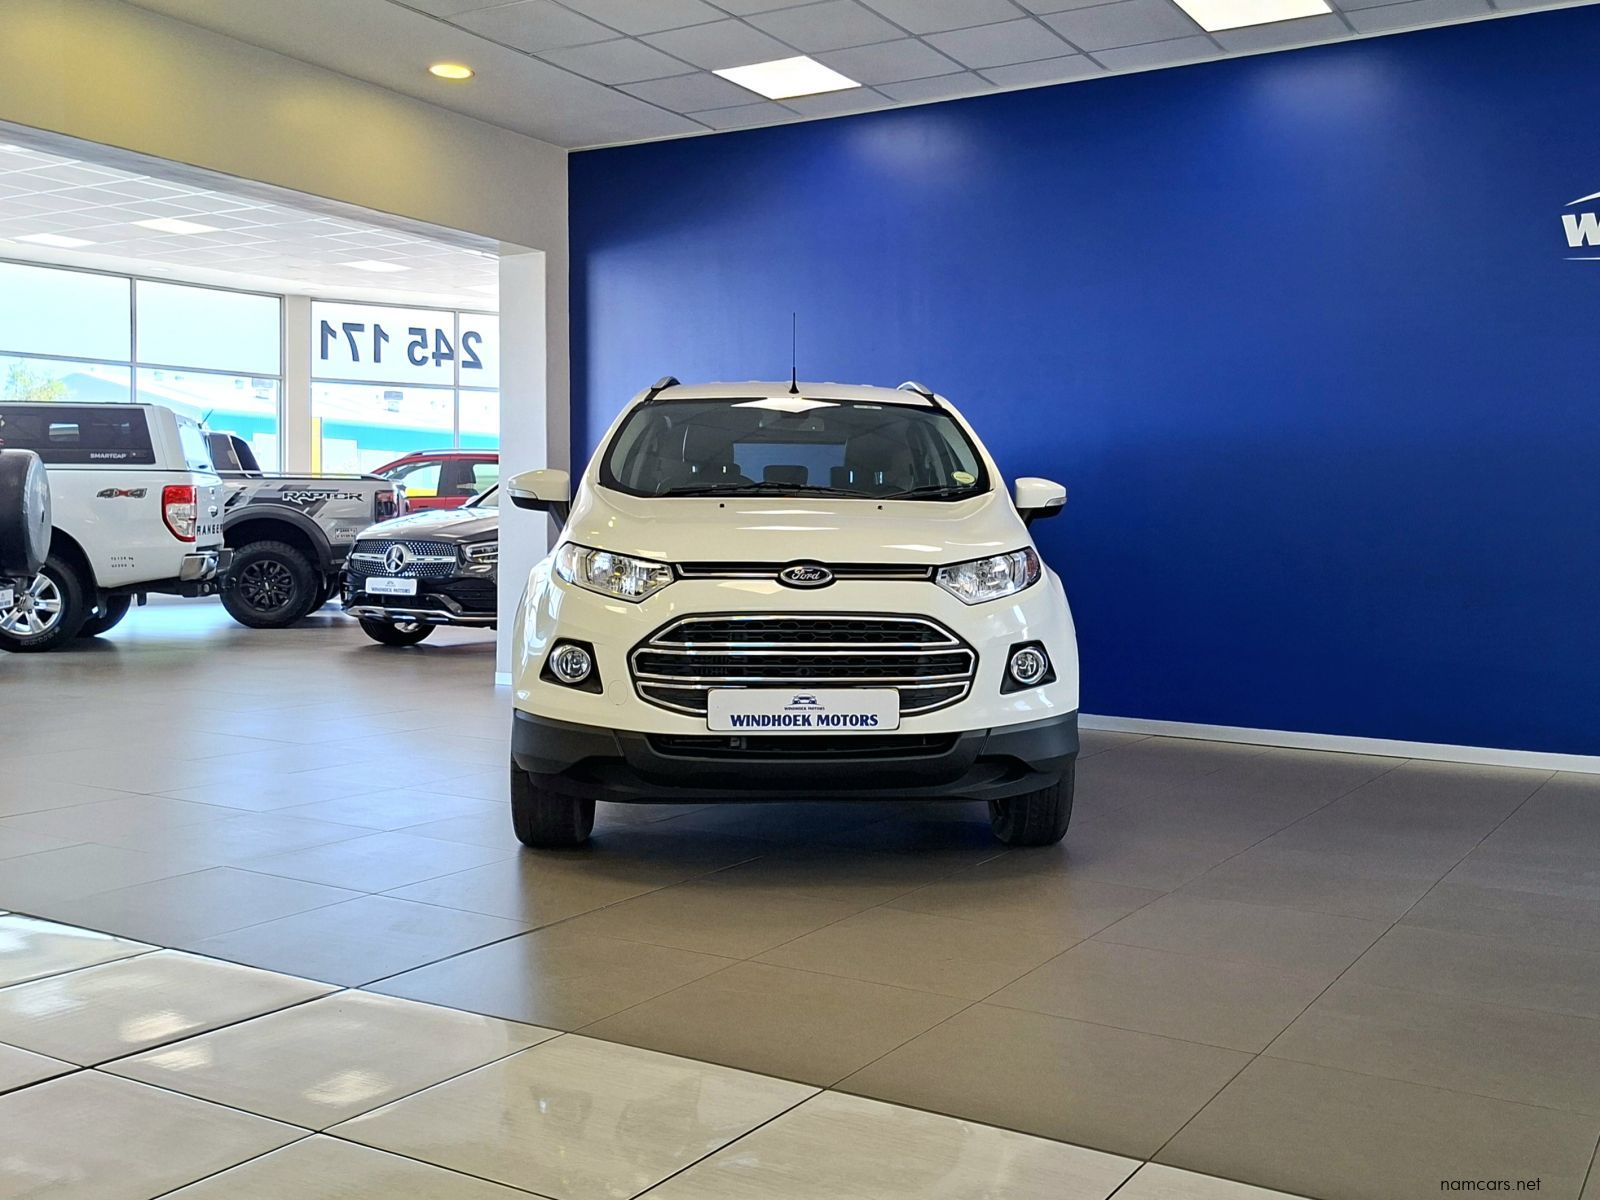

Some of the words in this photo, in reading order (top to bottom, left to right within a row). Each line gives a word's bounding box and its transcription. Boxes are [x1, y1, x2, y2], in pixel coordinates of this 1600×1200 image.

[282, 490, 364, 505] RAPTOR
[730, 714, 813, 727] WINDHOEK
[816, 714, 879, 727] MOTORS
